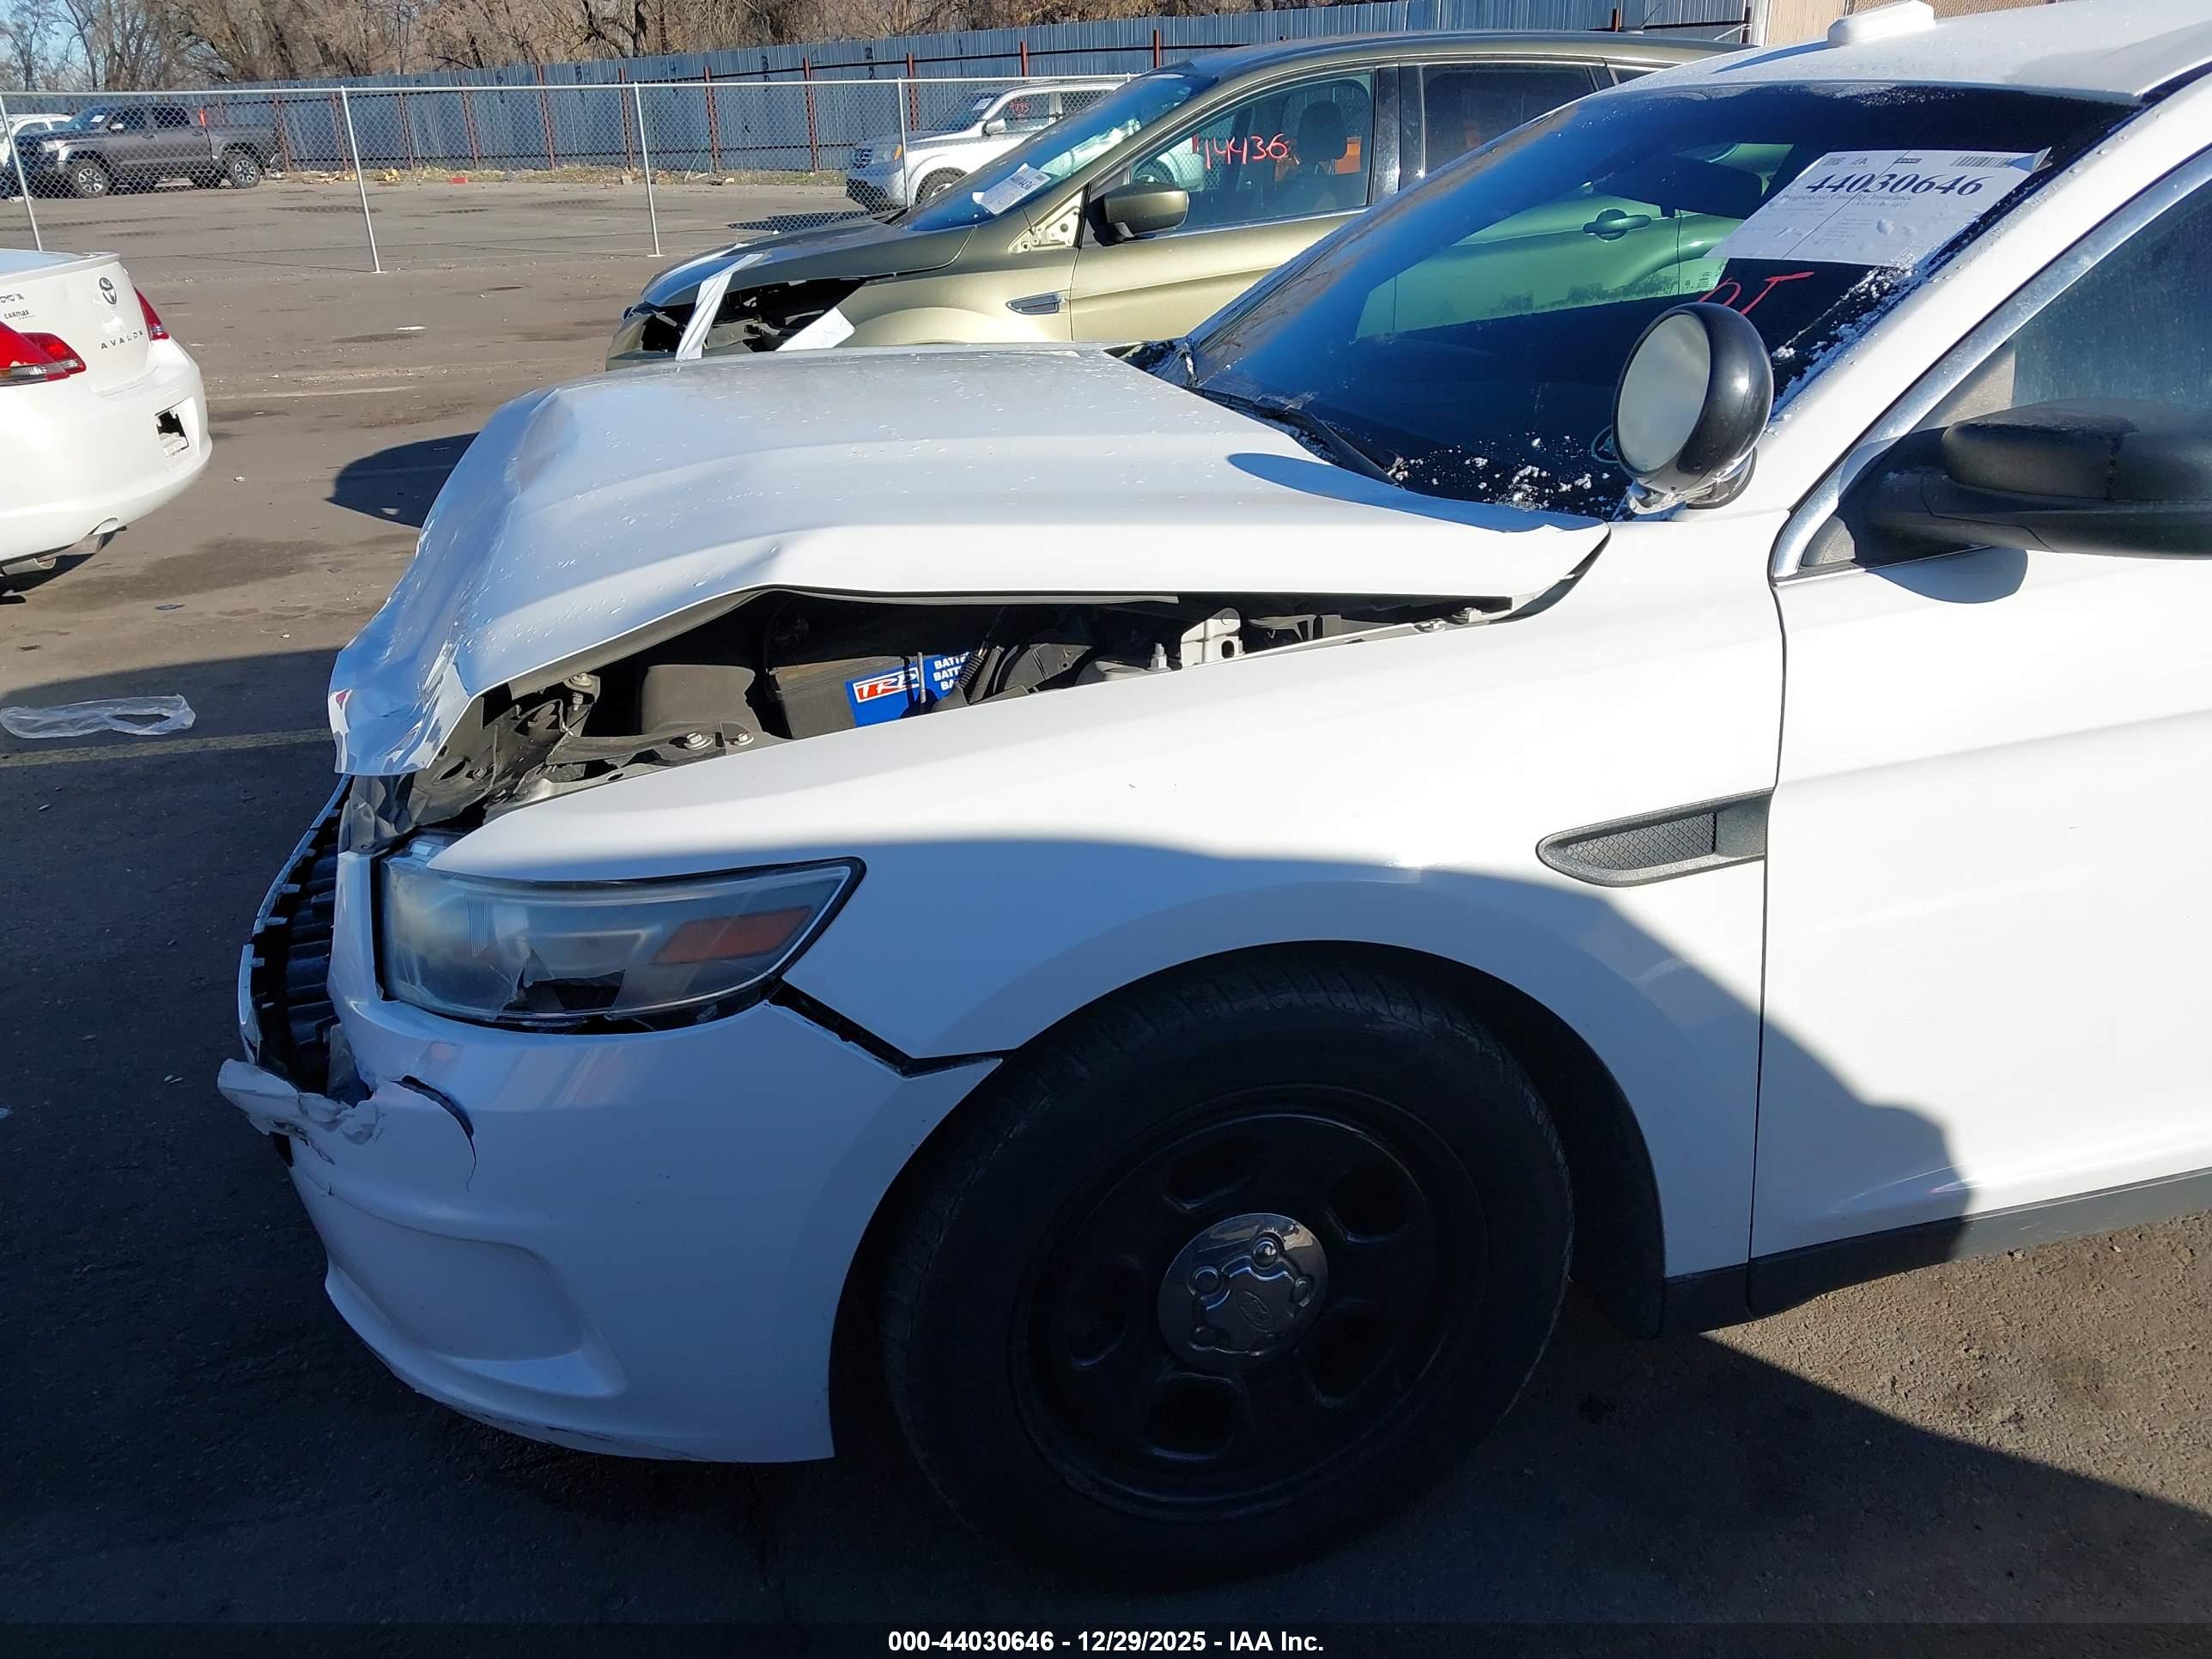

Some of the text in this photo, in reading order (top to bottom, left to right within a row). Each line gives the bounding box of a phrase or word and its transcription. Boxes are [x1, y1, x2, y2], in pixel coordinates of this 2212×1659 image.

[1205, 132, 1288, 170] 14436
[1806, 173, 1995, 196] 44030646
[100, 330, 144, 350] AVALON
